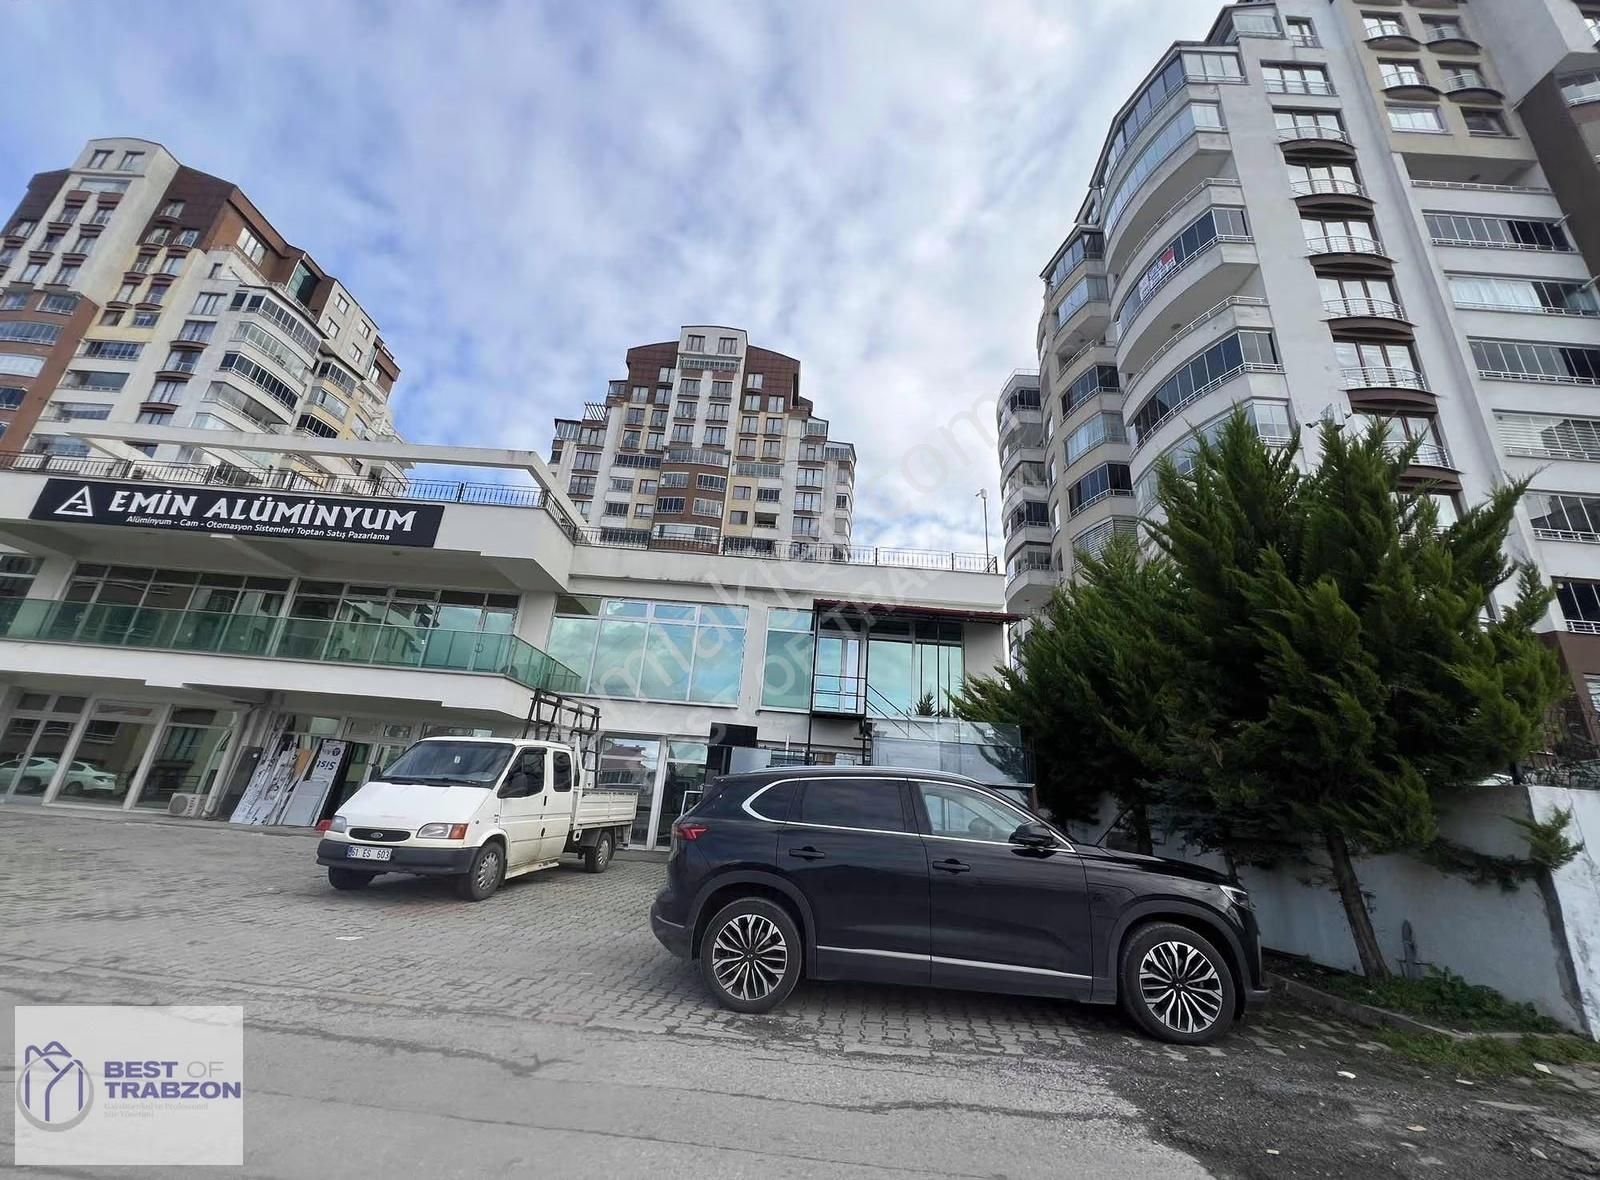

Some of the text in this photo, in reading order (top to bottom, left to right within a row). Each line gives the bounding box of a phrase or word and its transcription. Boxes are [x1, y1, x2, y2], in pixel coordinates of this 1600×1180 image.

[108, 490, 418, 532] EMİN ALÜMİNYUM
[126, 515, 172, 527] Alüminyum
[180, 519, 199, 527] Cam
[206, 520, 253, 532] Otomasyon
[254, 524, 295, 534] Sistemleri
[296, 527, 325, 537] Toptan
[326, 530, 346, 539] Satış
[348, 532, 390, 541] Pazarlama
[362, 849, 371, 858] ES
[376, 850, 390, 860] 603
